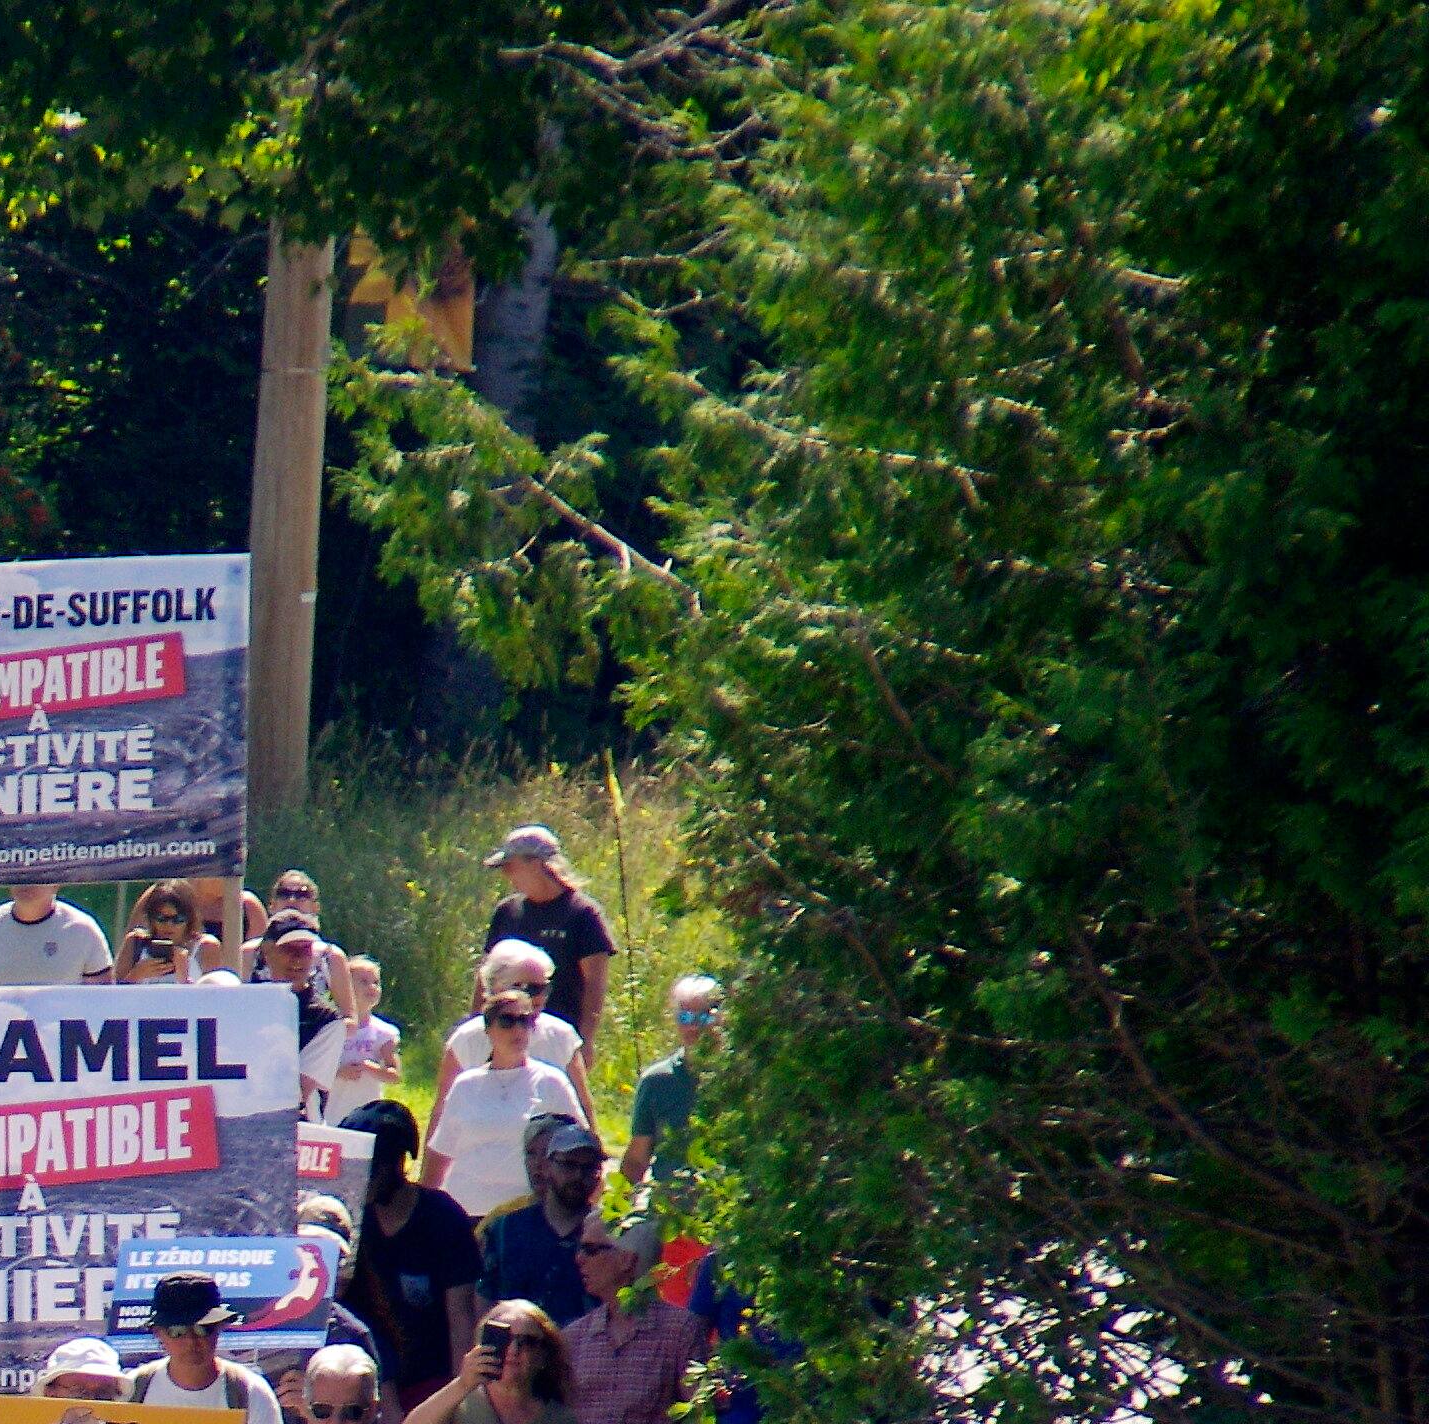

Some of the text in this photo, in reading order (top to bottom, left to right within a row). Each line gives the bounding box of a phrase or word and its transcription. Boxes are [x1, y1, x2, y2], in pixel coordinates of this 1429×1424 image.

[28, 704, 49, 731] À
[18, 1175, 47, 1212] À
[129, 1246, 276, 1267] LE ZÉRO RISQUE
[220, 1271, 252, 1289] PAS
